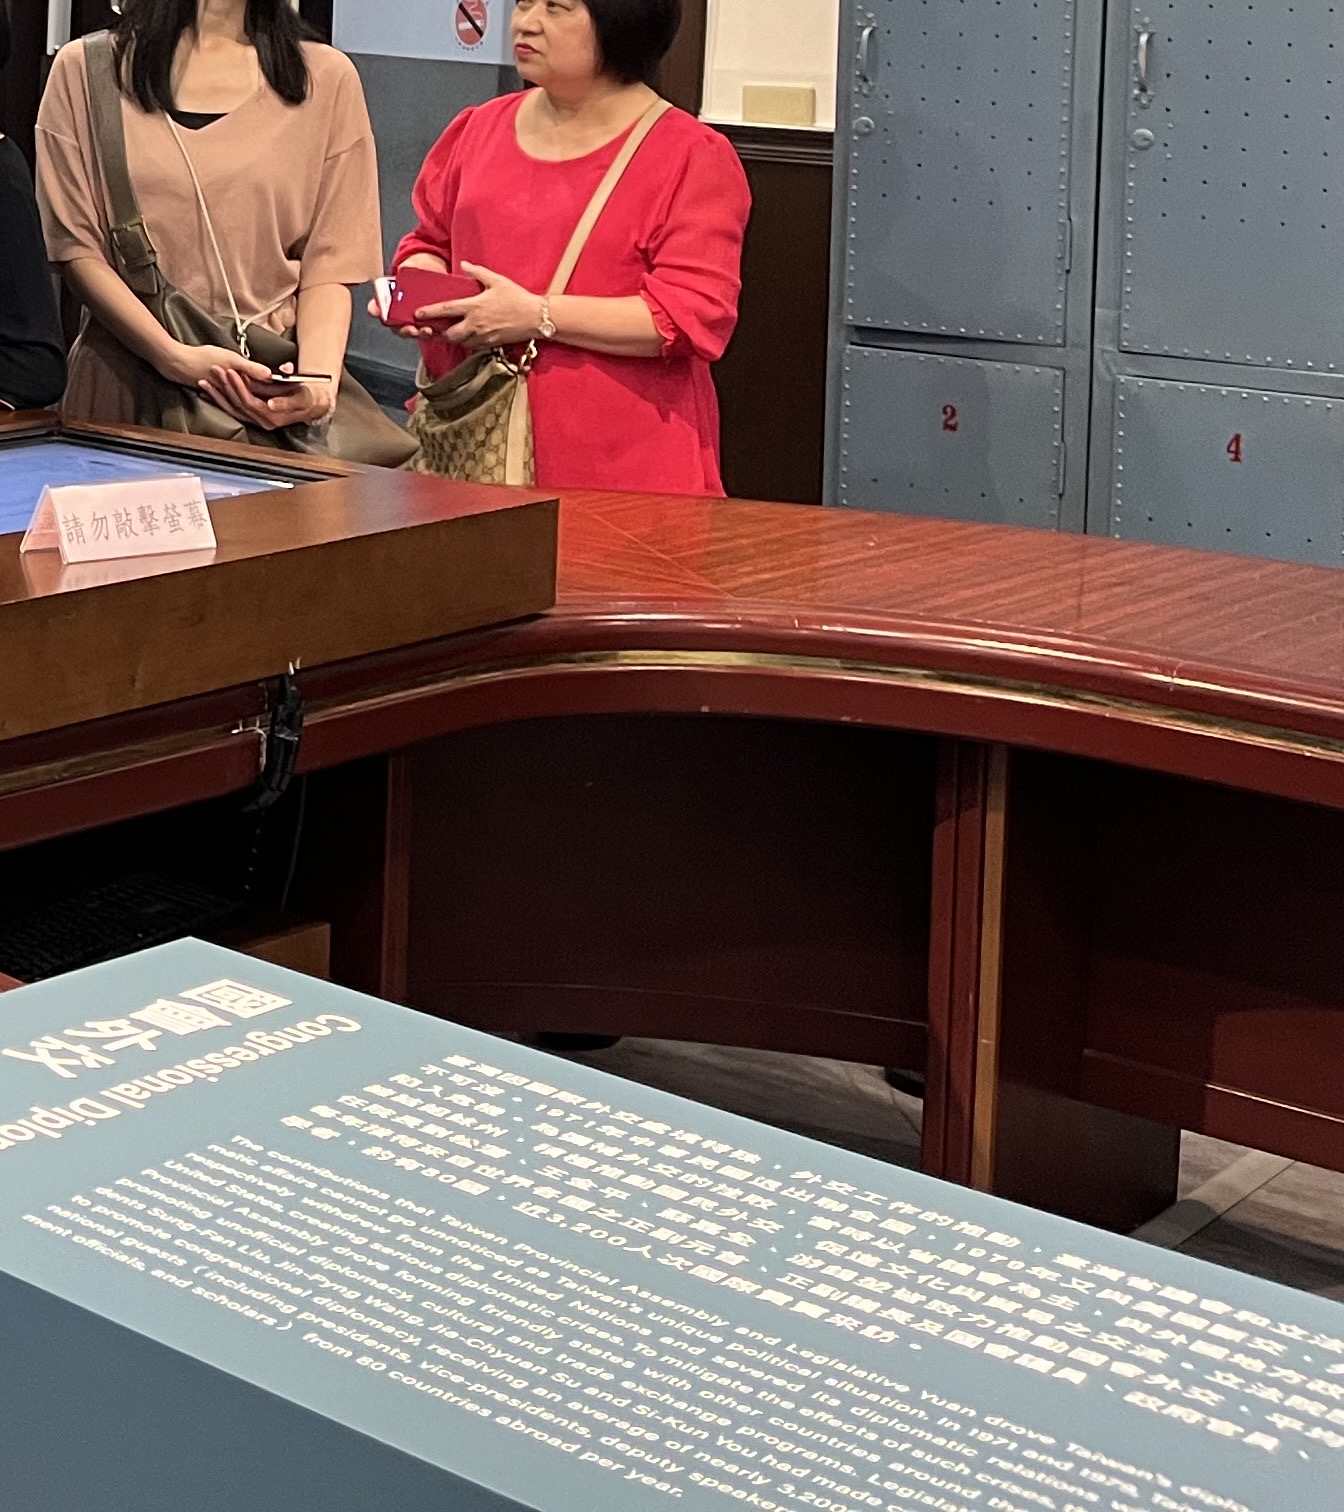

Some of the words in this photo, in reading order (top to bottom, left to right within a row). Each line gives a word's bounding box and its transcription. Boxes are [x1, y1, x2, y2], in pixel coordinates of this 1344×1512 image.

[62, 499, 208, 545] 請勿敲擊螢幕
[942, 404, 959, 433] 2
[1226, 434, 1243, 464] 4
[1, 978, 294, 1080] 國會外交
[99, 1014, 362, 1109] Congressional
[22, 1214, 73, 1237] ment
[71, 1235, 146, 1271] officials,
[150, 1269, 194, 1288] and
[302, 1332, 353, 1358] from
[355, 1356, 387, 1371] 80
[388, 1370, 493, 1417] countries
[495, 1416, 582, 1453] abroad
[578, 1451, 626, 1471] per
[623, 1469, 683, 1498] year.
[46, 1205, 125, 1238] national
[119, 1236, 188, 1266] guests
[296, 1311, 412, 1364] presidents,
[420, 1360, 592, 1438] vice-presidents,
[599, 1436, 685, 1473] deputy
[94, 1186, 147, 1211] dents
[146, 1207, 237, 1248] Sung-Fan
[237, 1244, 271, 1264] Liu,
[273, 1260, 362, 1300] Jin-Pyng
[364, 1294, 425, 1327] Wang,
[550, 1372, 582, 1388] Su
[583, 1387, 632, 1408] and
[632, 1404, 710, 1440] Si-Kun
[716, 1435, 758, 1458] You
[760, 1454, 812, 1478] had
[811, 1475, 883, 1506] made
[114, 1178, 213, 1220] promoting
[215, 1217, 308, 1256] unofficial
[307, 1255, 414, 1303] diplomacy,
[420, 1301, 505, 1336] cultural
[506, 1335, 554, 1355] and
[555, 1353, 615, 1381] trade
[621, 1380, 732, 1426] exchange
[735, 1426, 857, 1477] programs.
[140, 1168, 234, 1208] Provincial
[233, 1207, 329, 1246] Assembly
[332, 1246, 390, 1271] drove
[394, 1270, 476, 1307] forming
[480, 1303, 564, 1340] friendly
[568, 1339, 636, 1369] states
[643, 1367, 692, 1391] with
[699, 1390, 764, 1416] other
[768, 1417, 881, 1463] countries
[888, 1462, 982, 1500] around
[163, 1160, 227, 1187] United
[224, 1184, 284, 1213] States,
[288, 1210, 369, 1245] creating
[369, 1242, 444, 1274] serious
[445, 1272, 556, 1318] diplomatic
[557, 1316, 624, 1347] crises.
[632, 1342, 658, 1357] To
[659, 1355, 754, 1394] mitigate
[756, 1390, 796, 1410] the
[798, 1408, 879, 1441] effects
[882, 1438, 913, 1452] of
[910, 1449, 971, 1475] such
[231, 1135, 264, 1152] The
[267, 1150, 391, 1200] contributions
[394, 1198, 435, 1217] that
[440, 1214, 509, 1245] Taiwan
[513, 1242, 620, 1286] Provincial
[620, 1285, 730, 1327] Assembly
[734, 1326, 782, 1346] and
[785, 1343, 910, 1393] Legislative
[920, 1390, 977, 1417] Yuan
[984, 1416, 1056, 1445] drove
